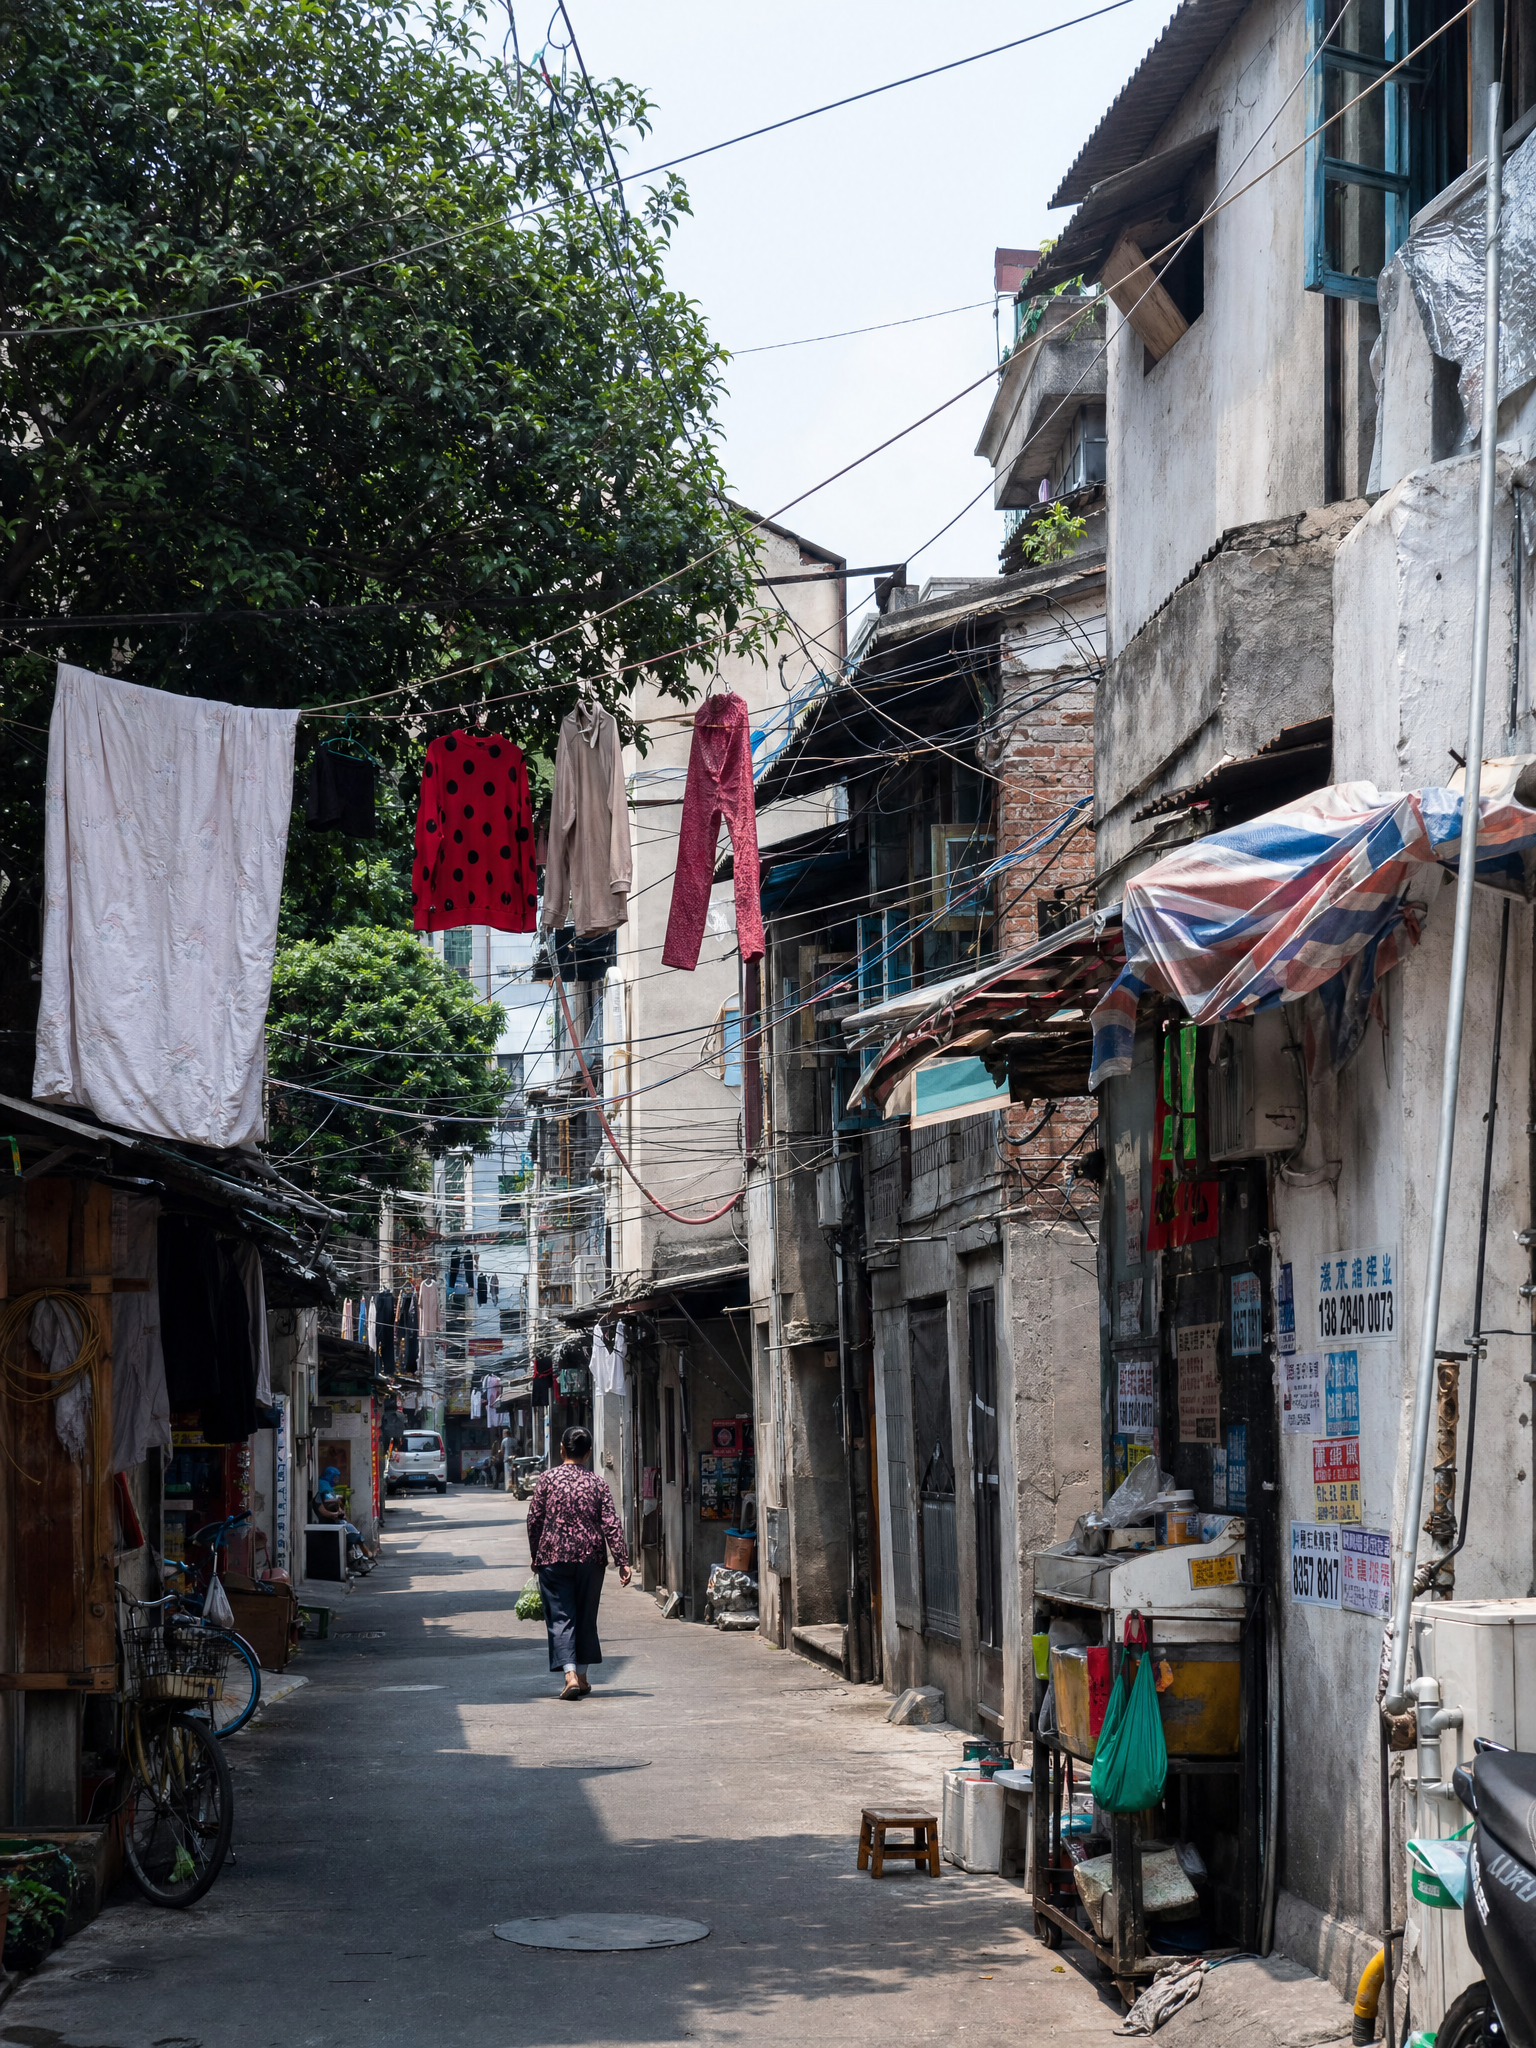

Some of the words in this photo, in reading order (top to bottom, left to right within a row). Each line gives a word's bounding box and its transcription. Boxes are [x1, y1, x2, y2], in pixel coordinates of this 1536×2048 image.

[1319, 1296, 1337, 1337] 138
[1340, 1293, 1365, 1335] 2840
[1367, 1290, 1394, 1333] 0073
[1293, 1555, 1314, 1597] 8357
[1317, 1557, 1339, 1600] 8817
